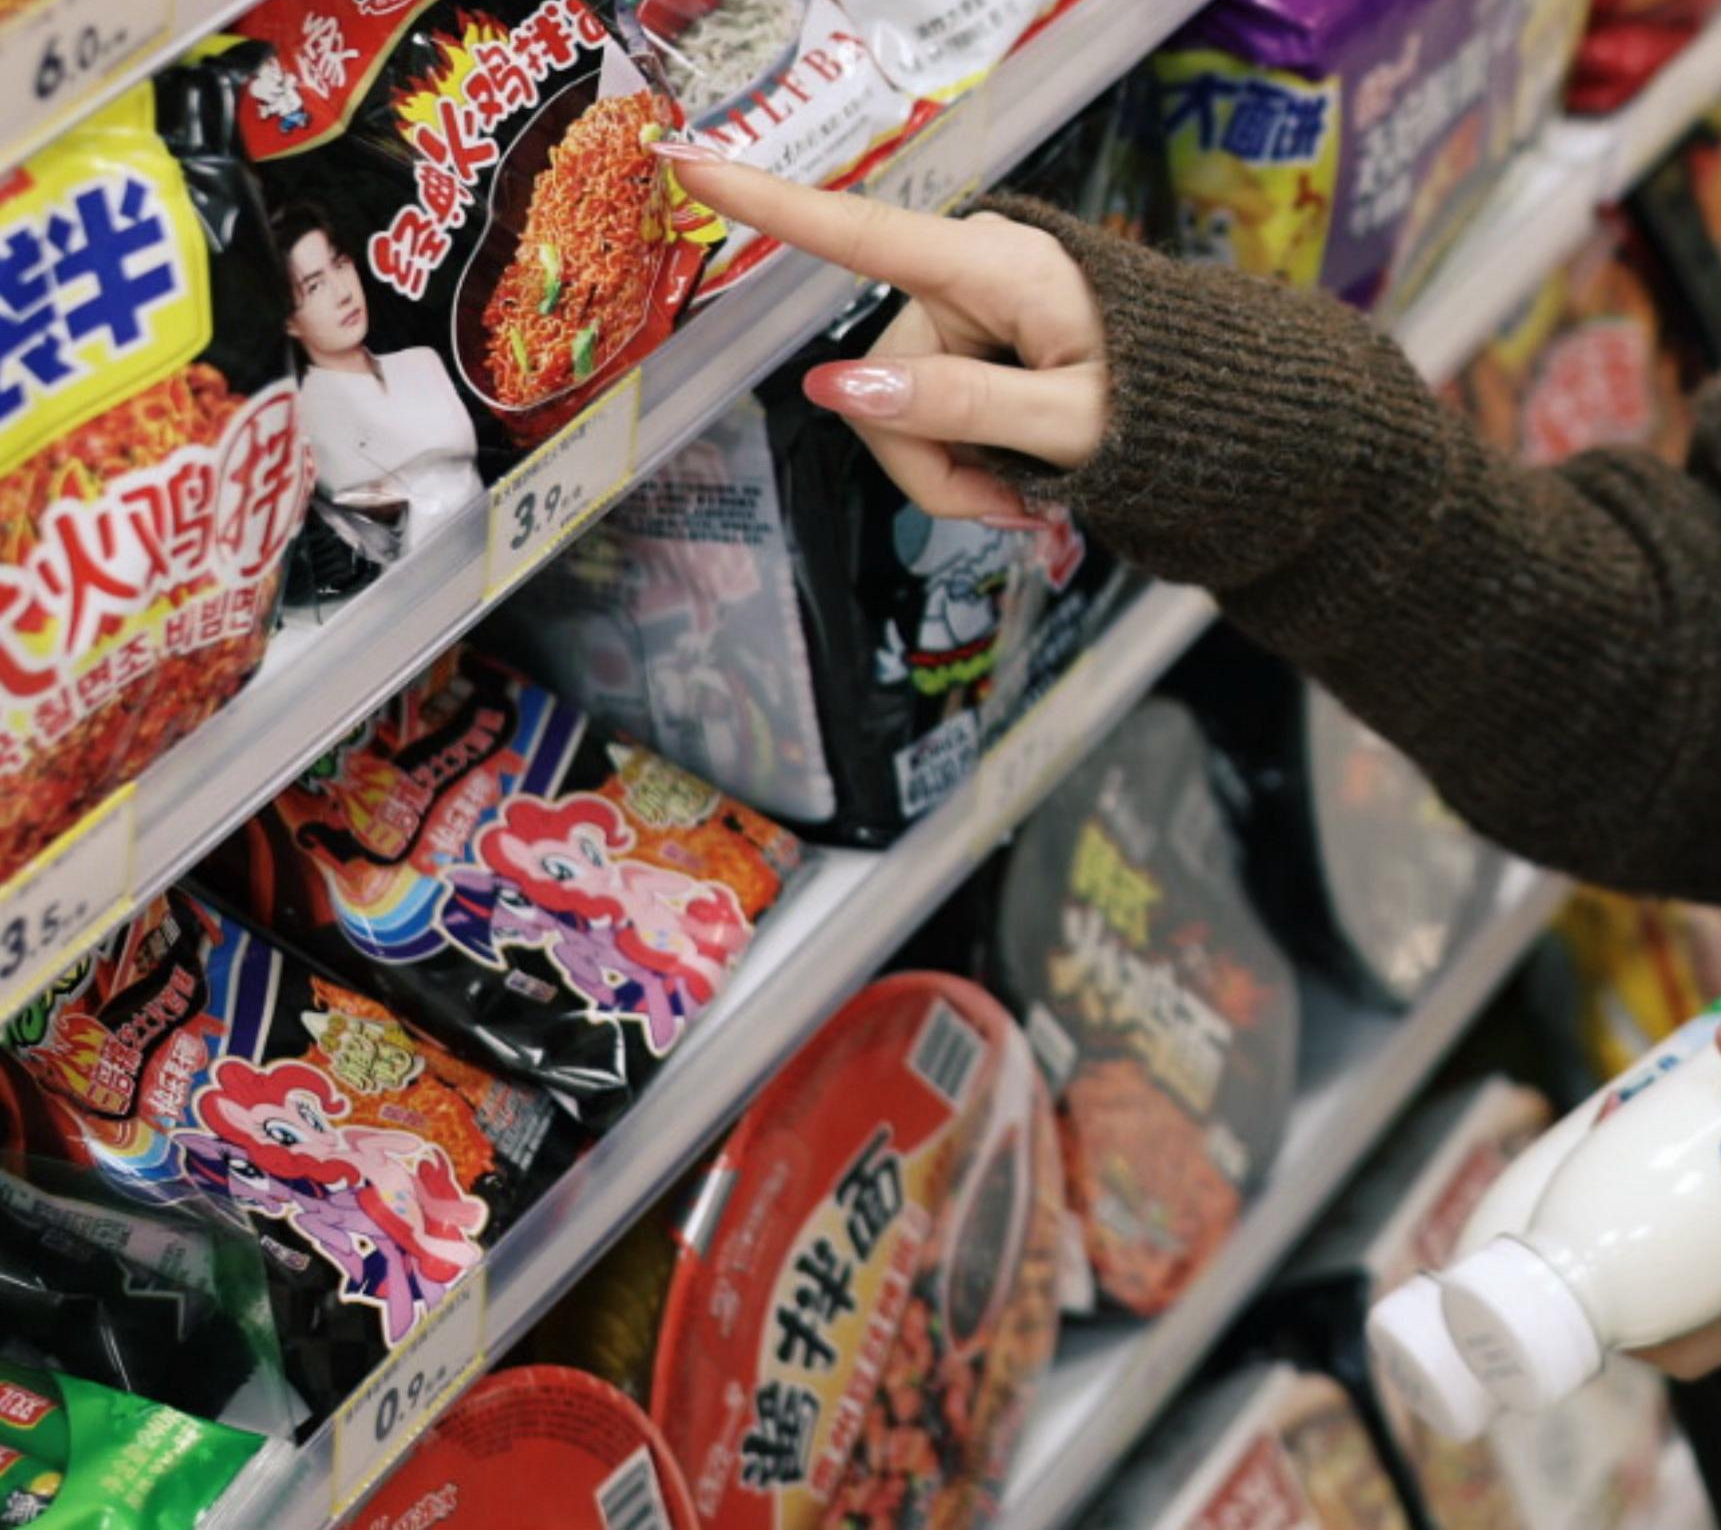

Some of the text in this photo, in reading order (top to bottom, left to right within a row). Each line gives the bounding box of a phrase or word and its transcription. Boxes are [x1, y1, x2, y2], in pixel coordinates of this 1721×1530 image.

[35, 26, 100, 99] 6.0
[510, 482, 564, 552] 3.9
[373, 1371, 425, 1443] 0.9
